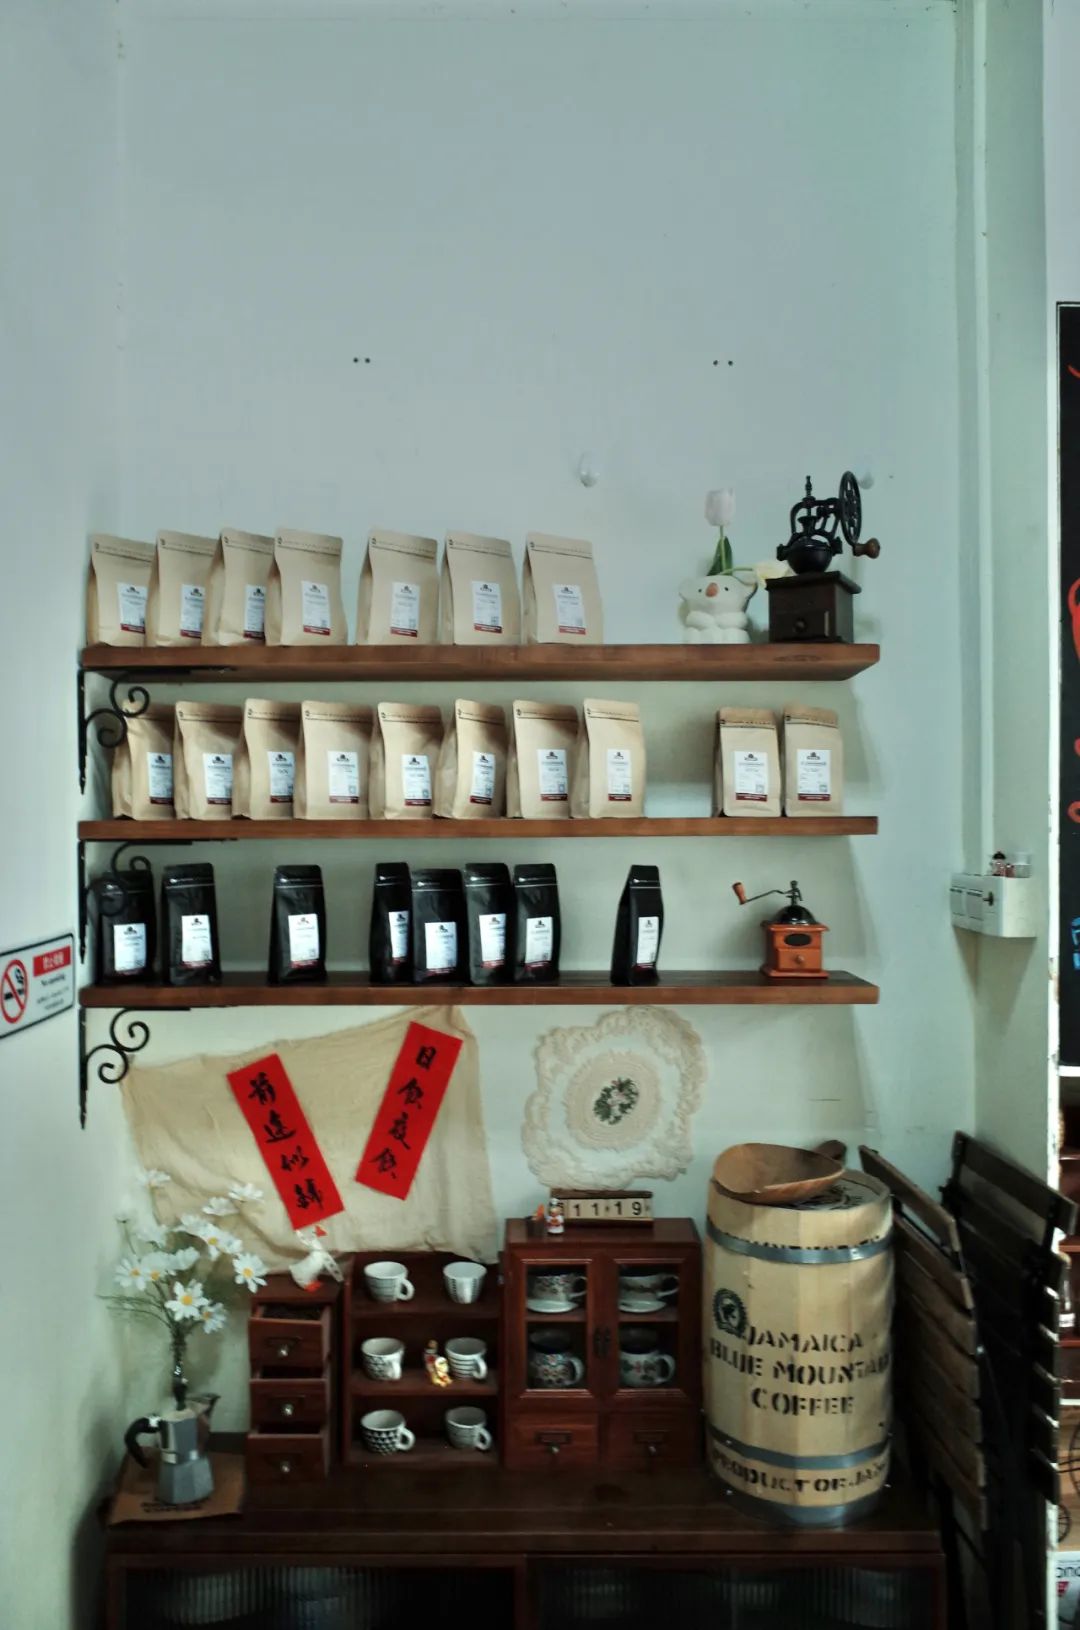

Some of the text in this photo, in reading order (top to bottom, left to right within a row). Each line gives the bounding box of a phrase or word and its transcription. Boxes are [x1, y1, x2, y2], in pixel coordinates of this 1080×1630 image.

[746, 1325, 864, 1353] JAMAICA
[709, 1337, 763, 1377] BLUE
[751, 1387, 855, 1416] COFFEE
